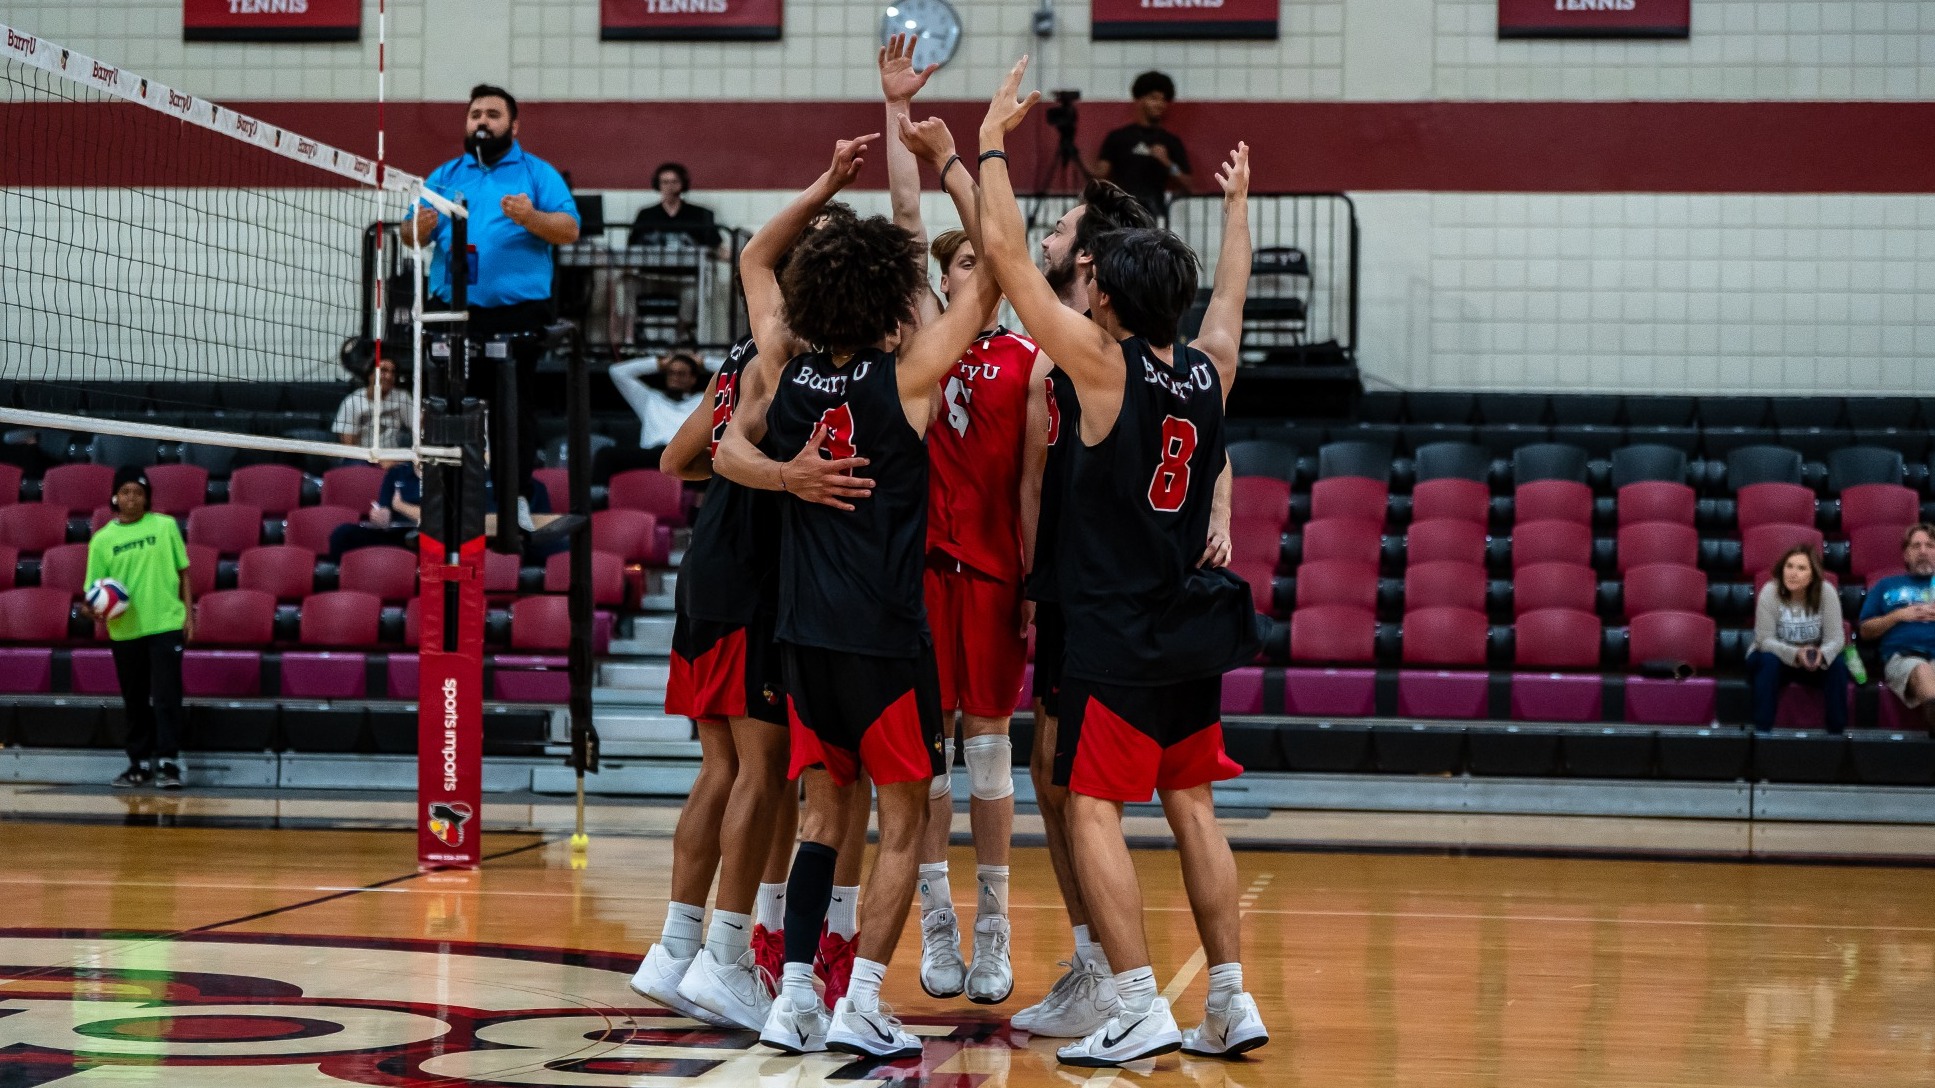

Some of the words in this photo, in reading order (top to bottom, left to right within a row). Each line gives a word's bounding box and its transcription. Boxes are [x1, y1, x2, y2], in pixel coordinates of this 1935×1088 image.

[228, 0, 309, 13] TENNIS
[646, 0, 729, 13] TENNIS
[944, 376, 972, 438] 6
[1148, 414, 1198, 512] 8
[441, 678, 459, 729] sports
[441, 730, 459, 792] imports
